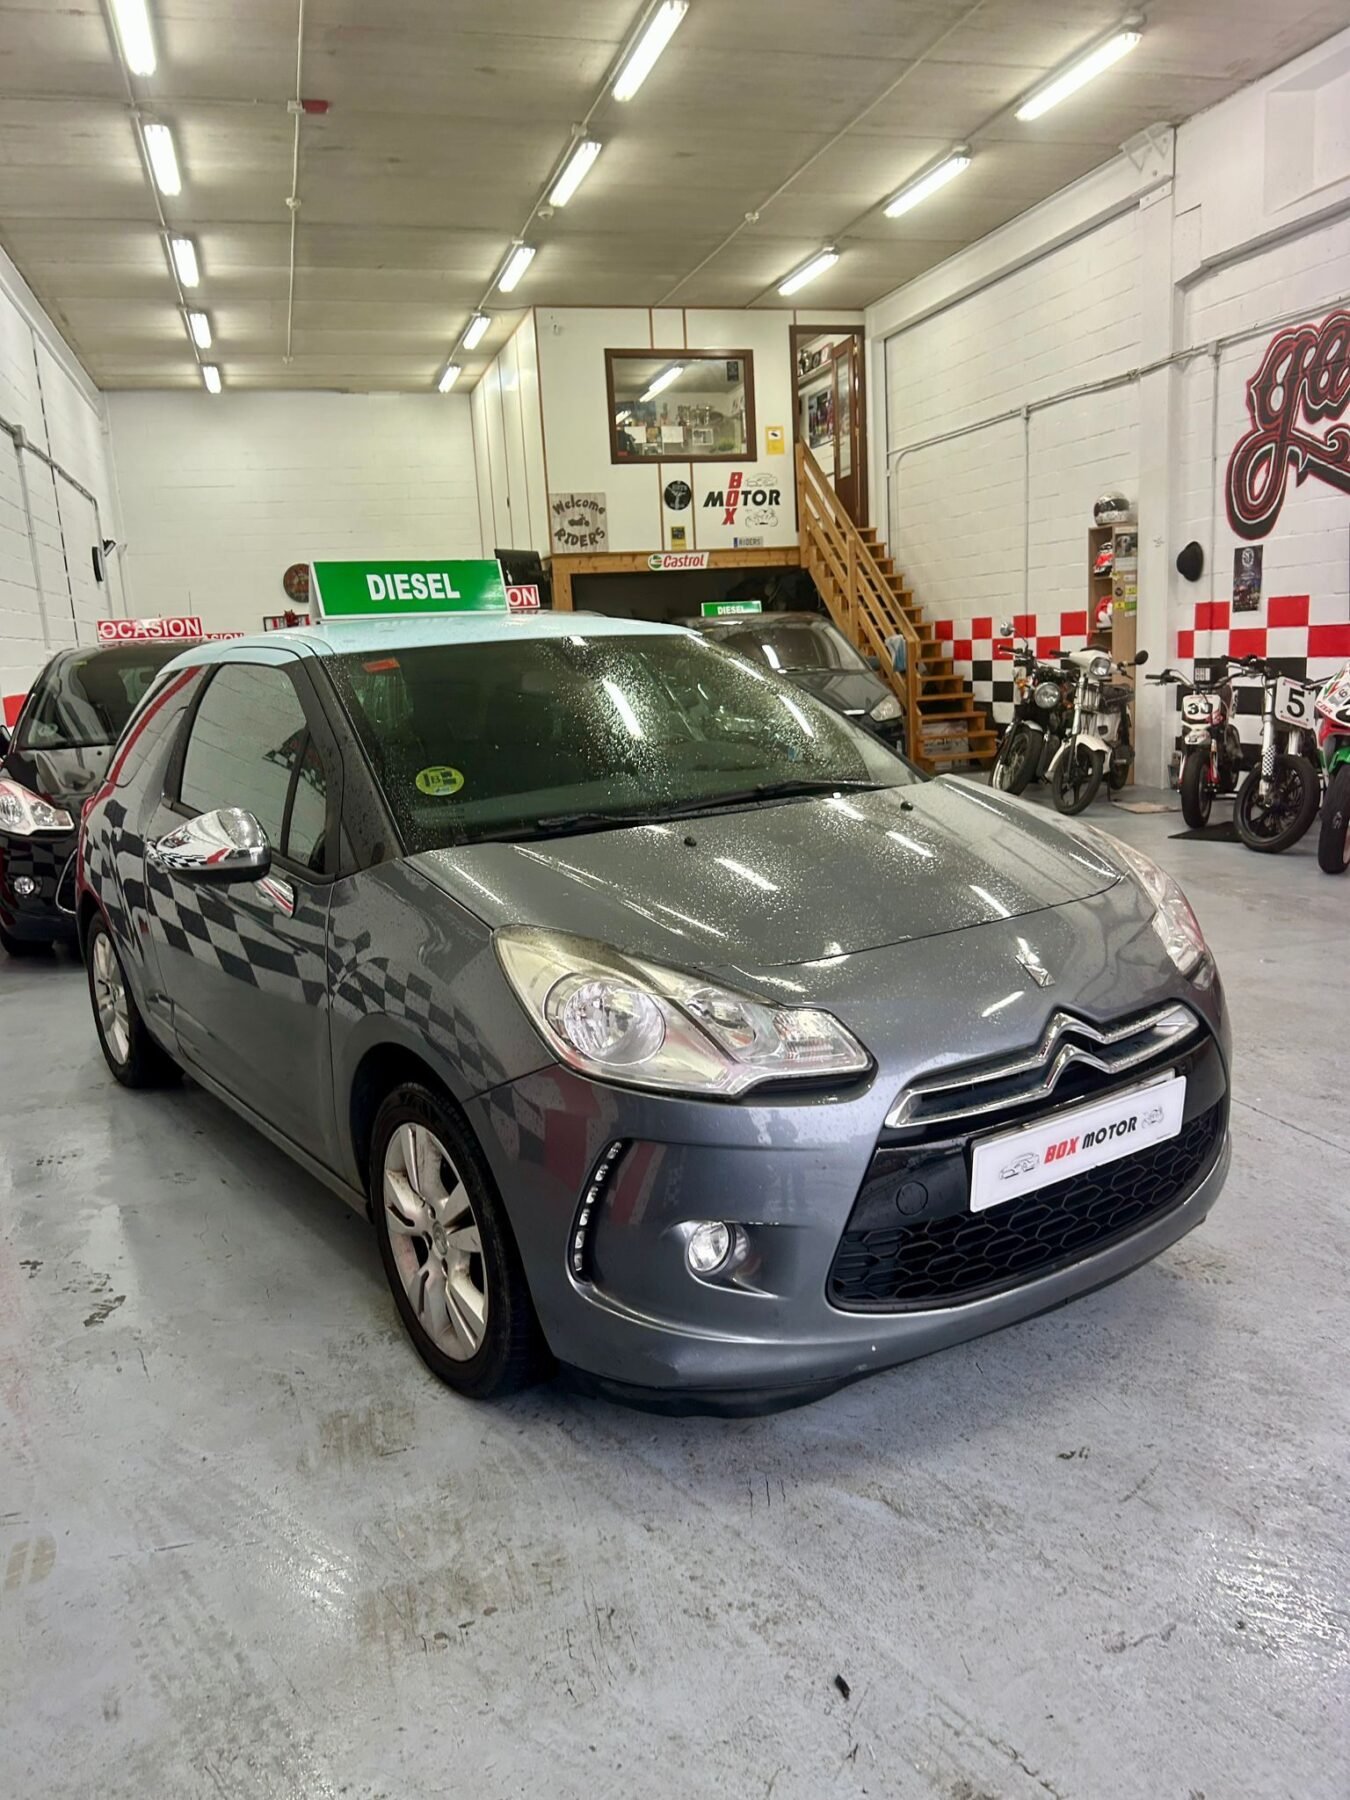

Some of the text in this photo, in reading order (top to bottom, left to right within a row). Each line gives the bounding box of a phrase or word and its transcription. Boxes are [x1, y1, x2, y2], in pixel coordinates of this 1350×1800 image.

[552, 494, 606, 515] Welcome
[703, 489, 781, 508] MOTOR
[554, 527, 605, 548] RIDERS
[663, 554, 705, 568] Castrol
[366, 573, 461, 600] DIESEL
[100, 618, 200, 639] OCASION
[1287, 687, 1305, 718] 5
[1044, 1116, 1138, 1164] BOX MOTOR
